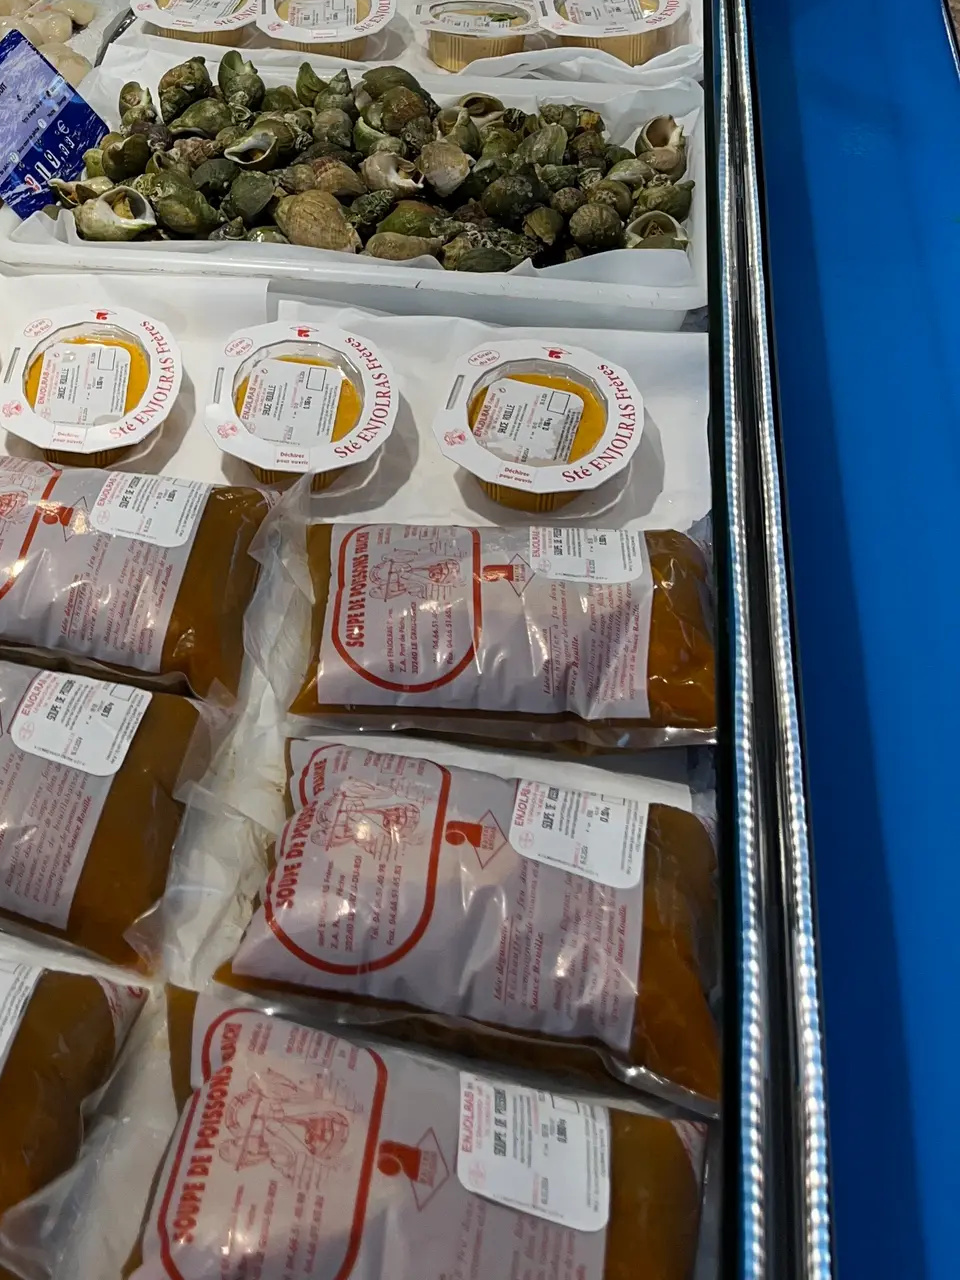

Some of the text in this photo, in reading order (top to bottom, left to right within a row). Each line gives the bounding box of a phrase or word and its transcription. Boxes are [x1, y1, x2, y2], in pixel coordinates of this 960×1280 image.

[109, 320, 176, 439] Sté ENJOLRAS Frères
[333, 337, 392, 459] Sté ENJOLRAS Frères
[561, 364, 636, 483] Sté ENJOLRAS Frères
[279, 451, 305, 459] Déchirer
[504, 467, 530, 477] Déchirer
[348, 597, 365, 613] DE
[46, 703, 63, 722] SOUPE
[55, 693, 67, 705] DE
